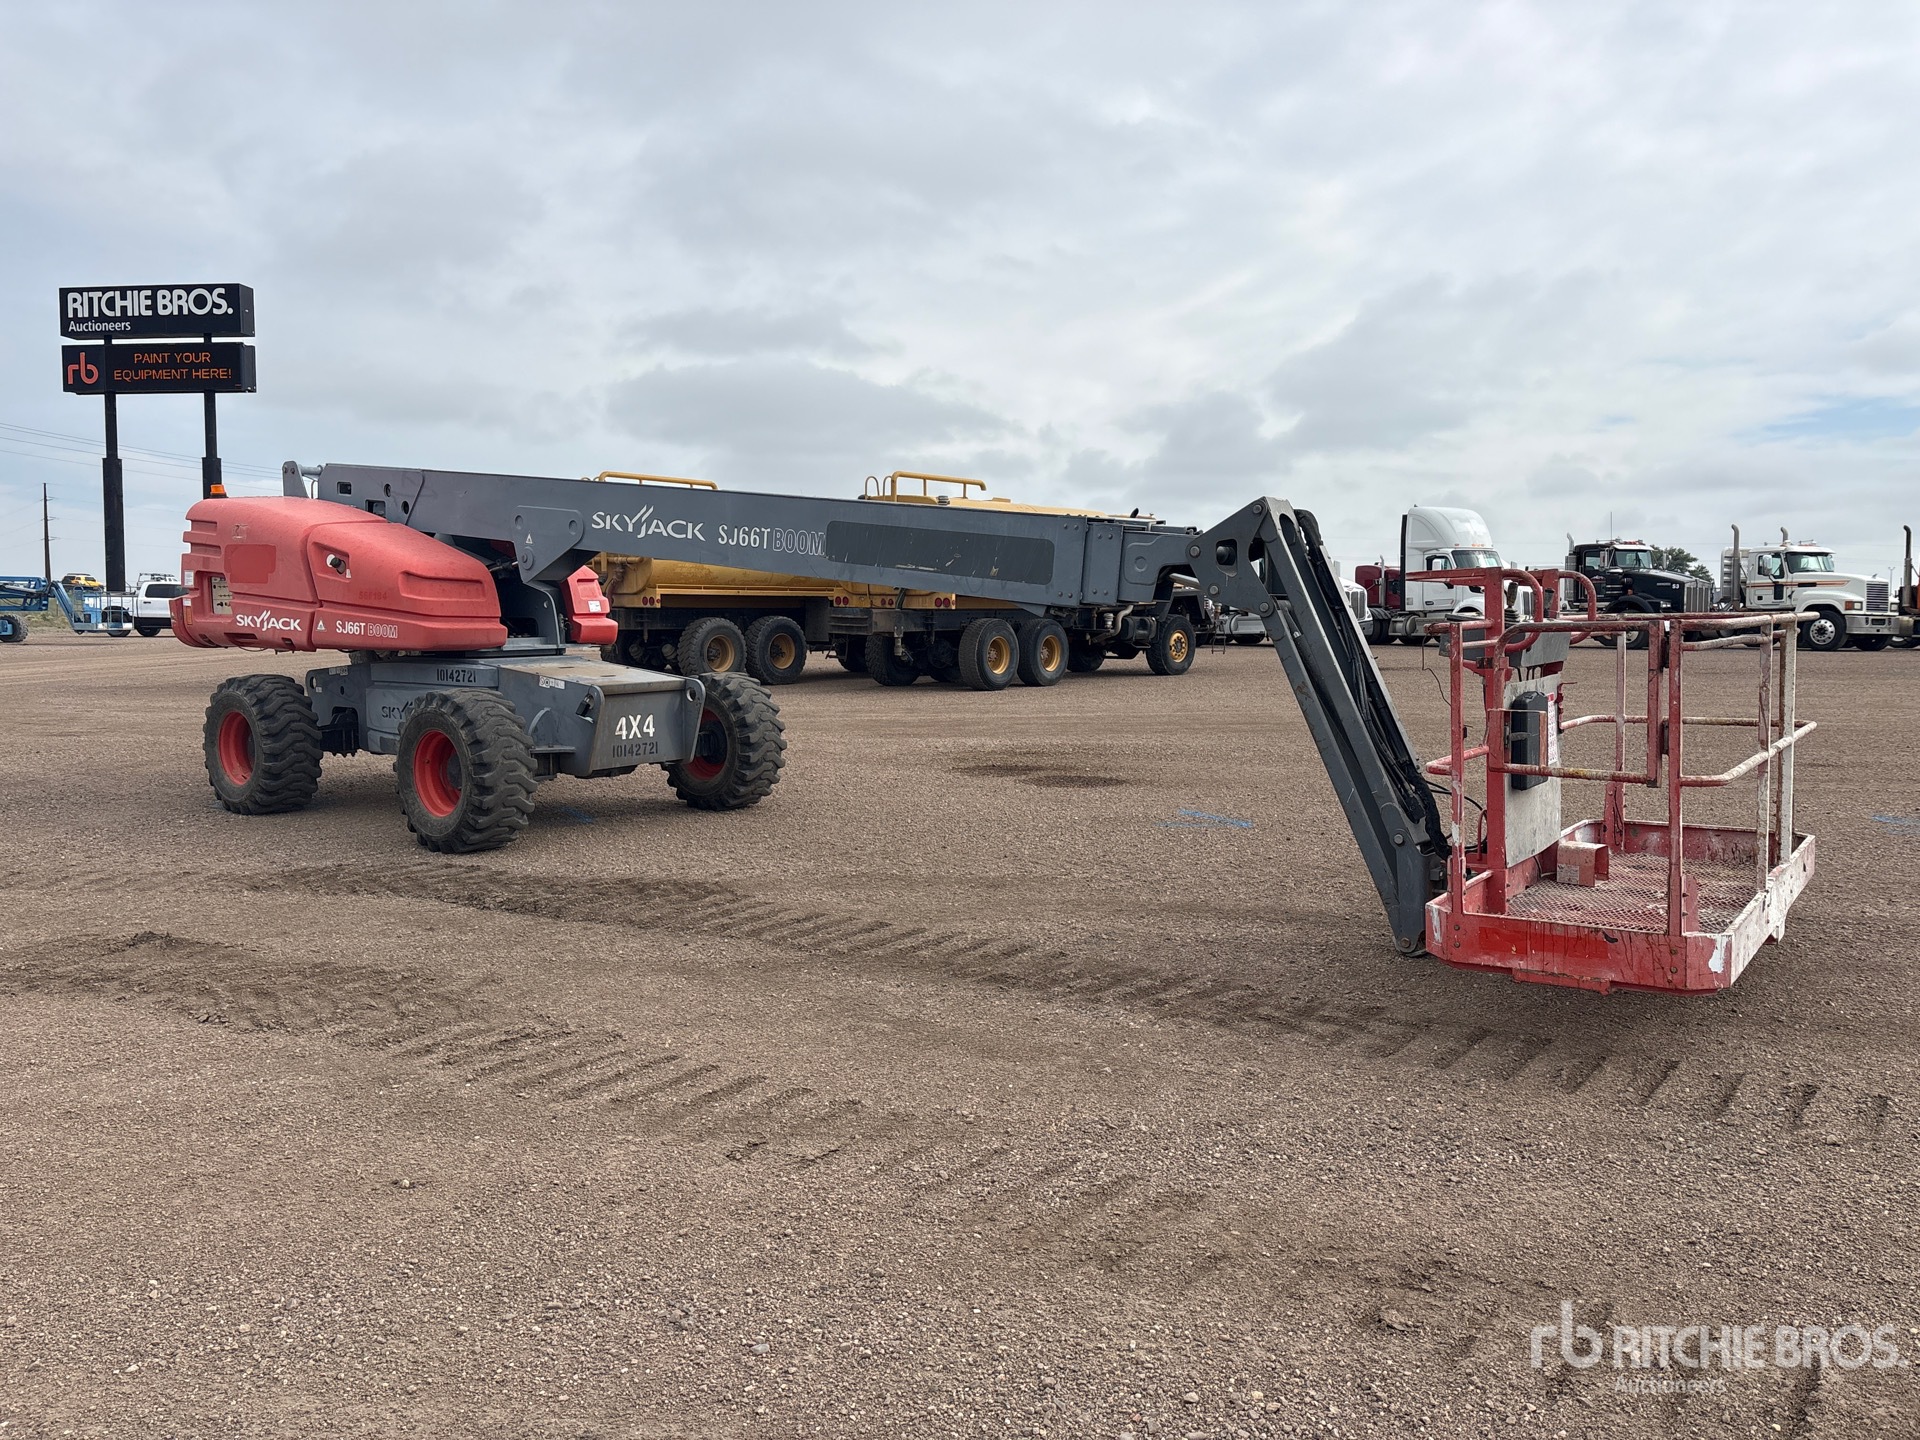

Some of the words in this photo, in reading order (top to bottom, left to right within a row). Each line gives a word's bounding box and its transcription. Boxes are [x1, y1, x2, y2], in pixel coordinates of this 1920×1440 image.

[67, 289, 153, 318] RITCHIE
[157, 288, 234, 316] BROS.
[68, 320, 131, 332] Auctioneers
[134, 353, 171, 364] PAINT
[175, 352, 211, 363] YOUR
[67, 352, 99, 385] rb
[114, 369, 189, 382] EQUIPMENT
[192, 368, 232, 379] HERE!
[591, 504, 706, 541] SKYJACK
[718, 524, 771, 550] SJ66T
[772, 528, 827, 556] BOOM
[236, 610, 302, 632] SKYJACK
[336, 620, 366, 636] SJ66T
[367, 623, 398, 638] BOOM
[436, 668, 476, 683] 10142721
[615, 714, 655, 740] 4X4
[612, 742, 659, 758] 10142721
